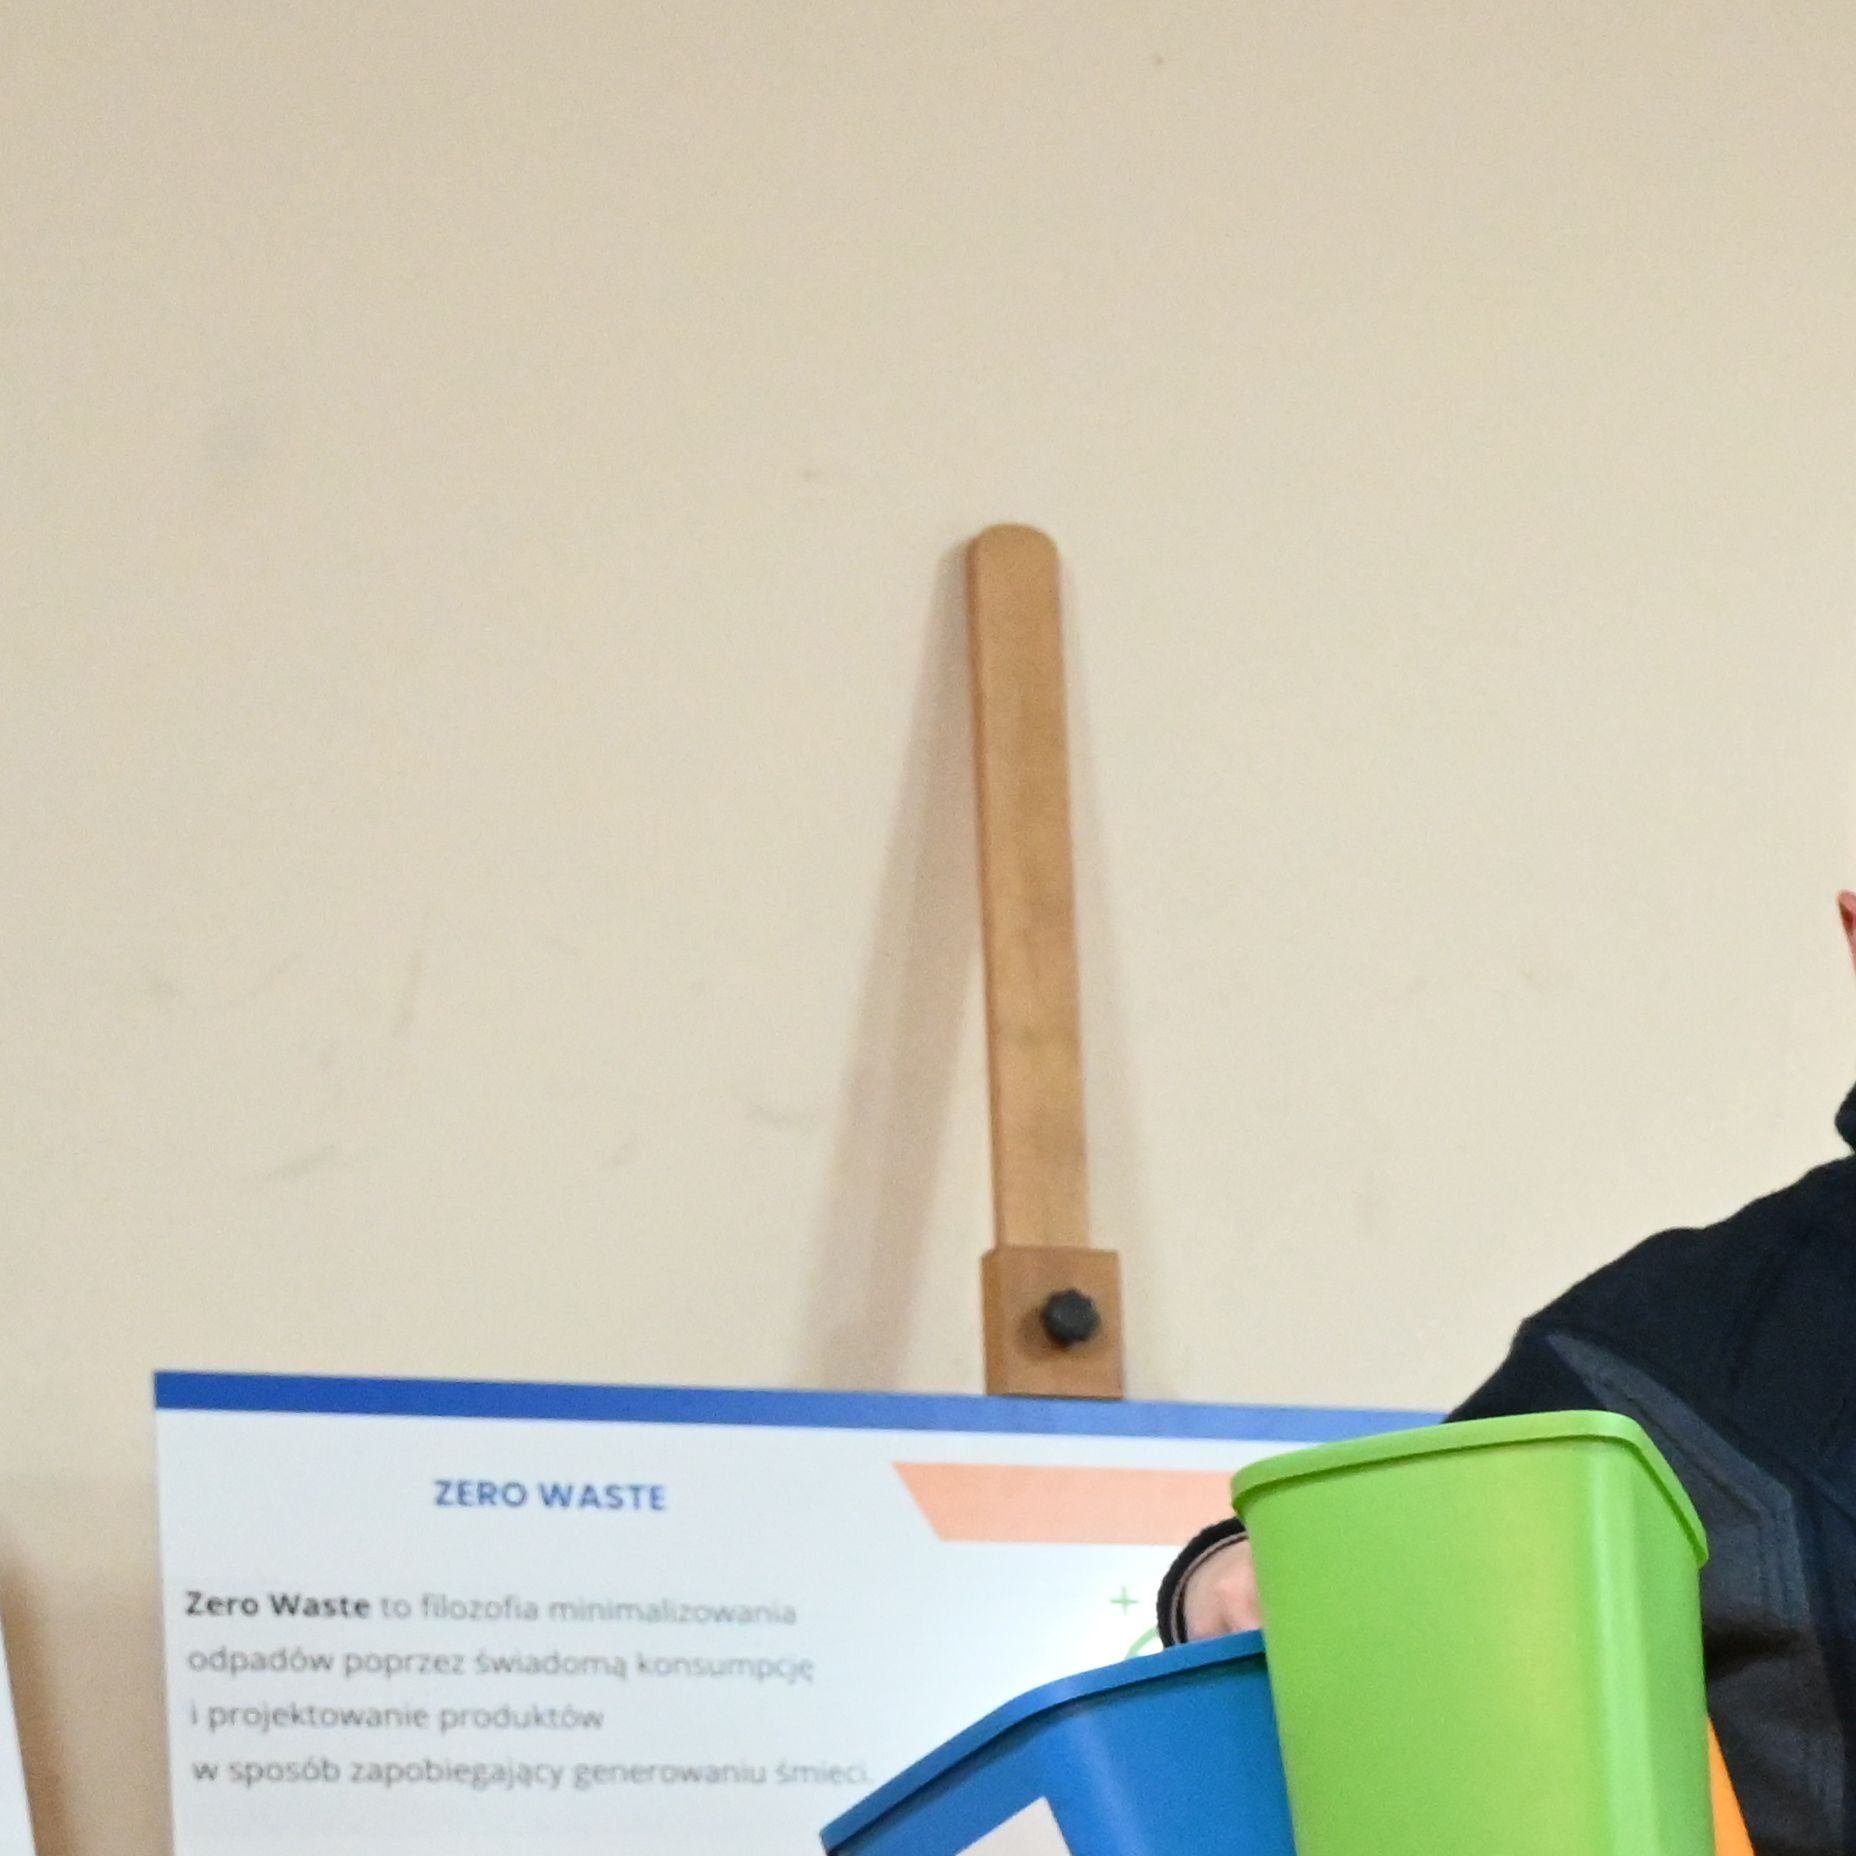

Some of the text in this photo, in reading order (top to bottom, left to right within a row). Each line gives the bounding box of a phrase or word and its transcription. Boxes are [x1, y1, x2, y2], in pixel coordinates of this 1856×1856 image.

[433, 1479, 667, 1512] ZERO WASTE
[185, 1590, 798, 1626] Zero Waste to filozofia minimalizowania
[188, 1645, 815, 1685] odpadów poprzez świadomą konsumpcję
[191, 1703, 605, 1734] i projektowanie produktów
[192, 1762, 217, 1783] w
[229, 1756, 341, 1789] sposób
[350, 1756, 565, 1790] zapobiegający
[573, 1758, 767, 1790] generowaniu
